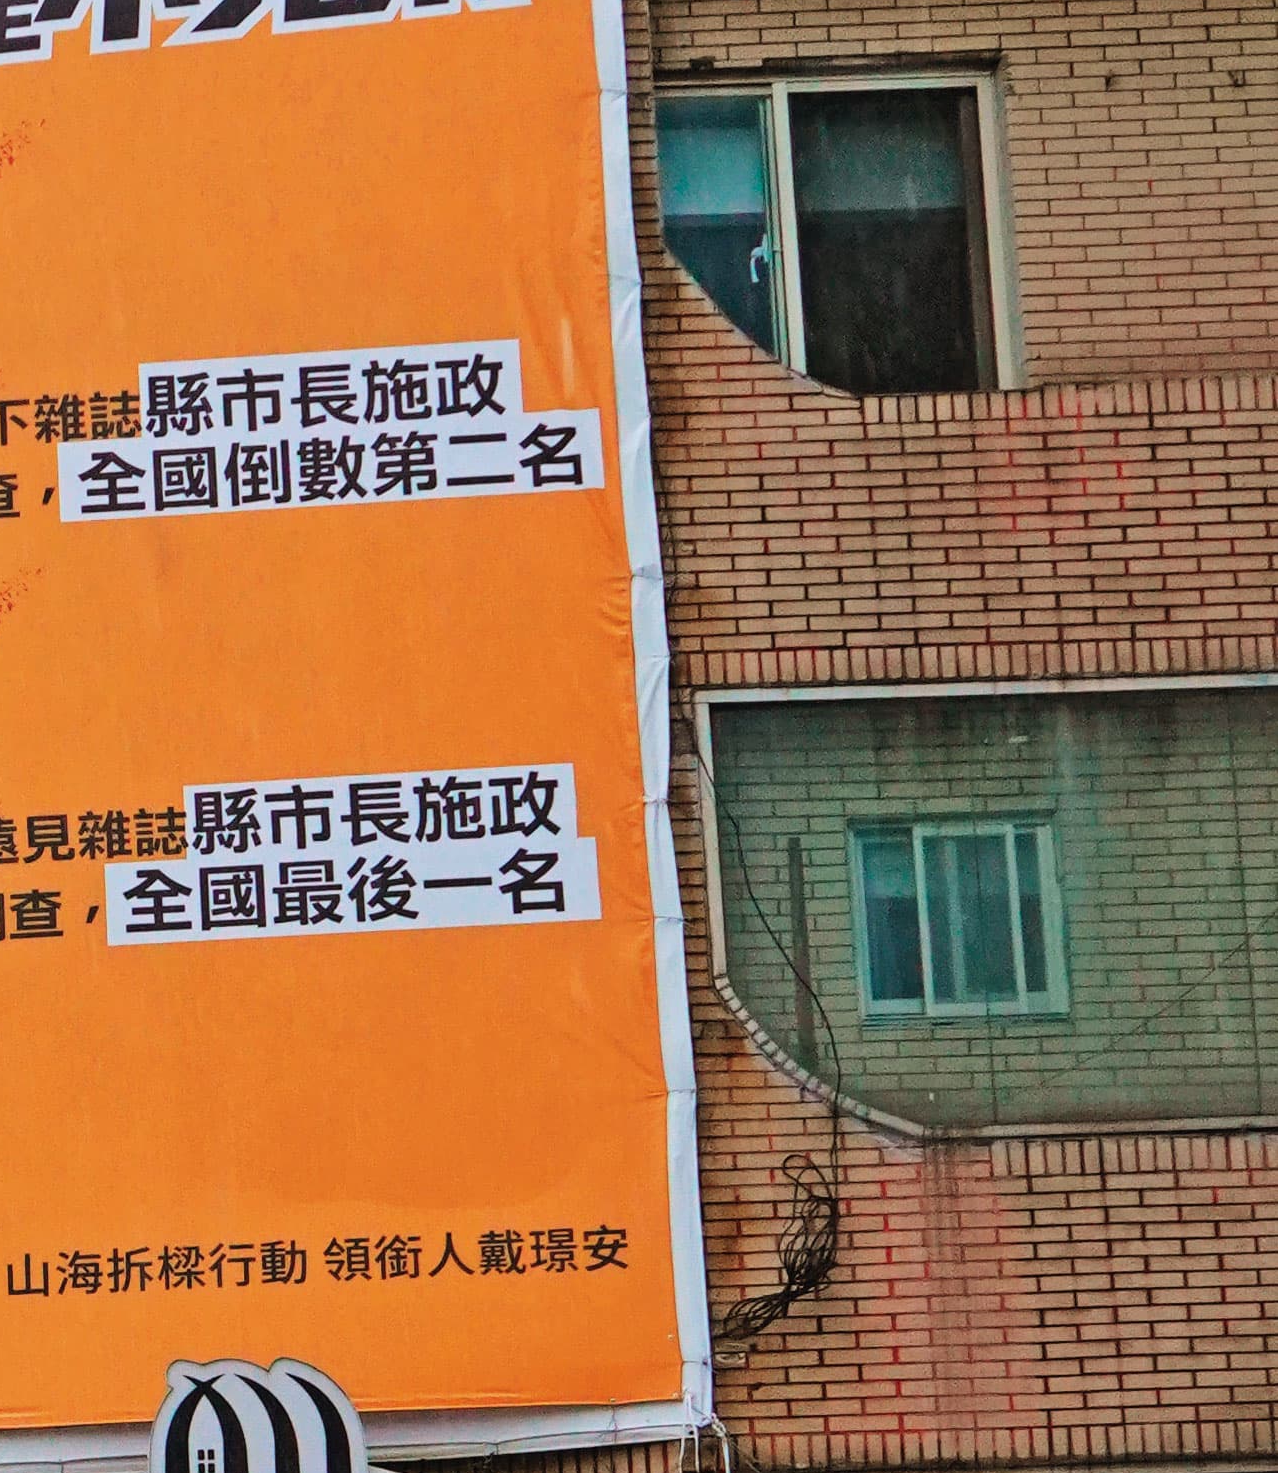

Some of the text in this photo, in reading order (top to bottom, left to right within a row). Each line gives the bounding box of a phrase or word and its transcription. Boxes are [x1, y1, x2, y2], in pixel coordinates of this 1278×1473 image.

[6, 1239, 309, 1297] 山海拆樑行動
